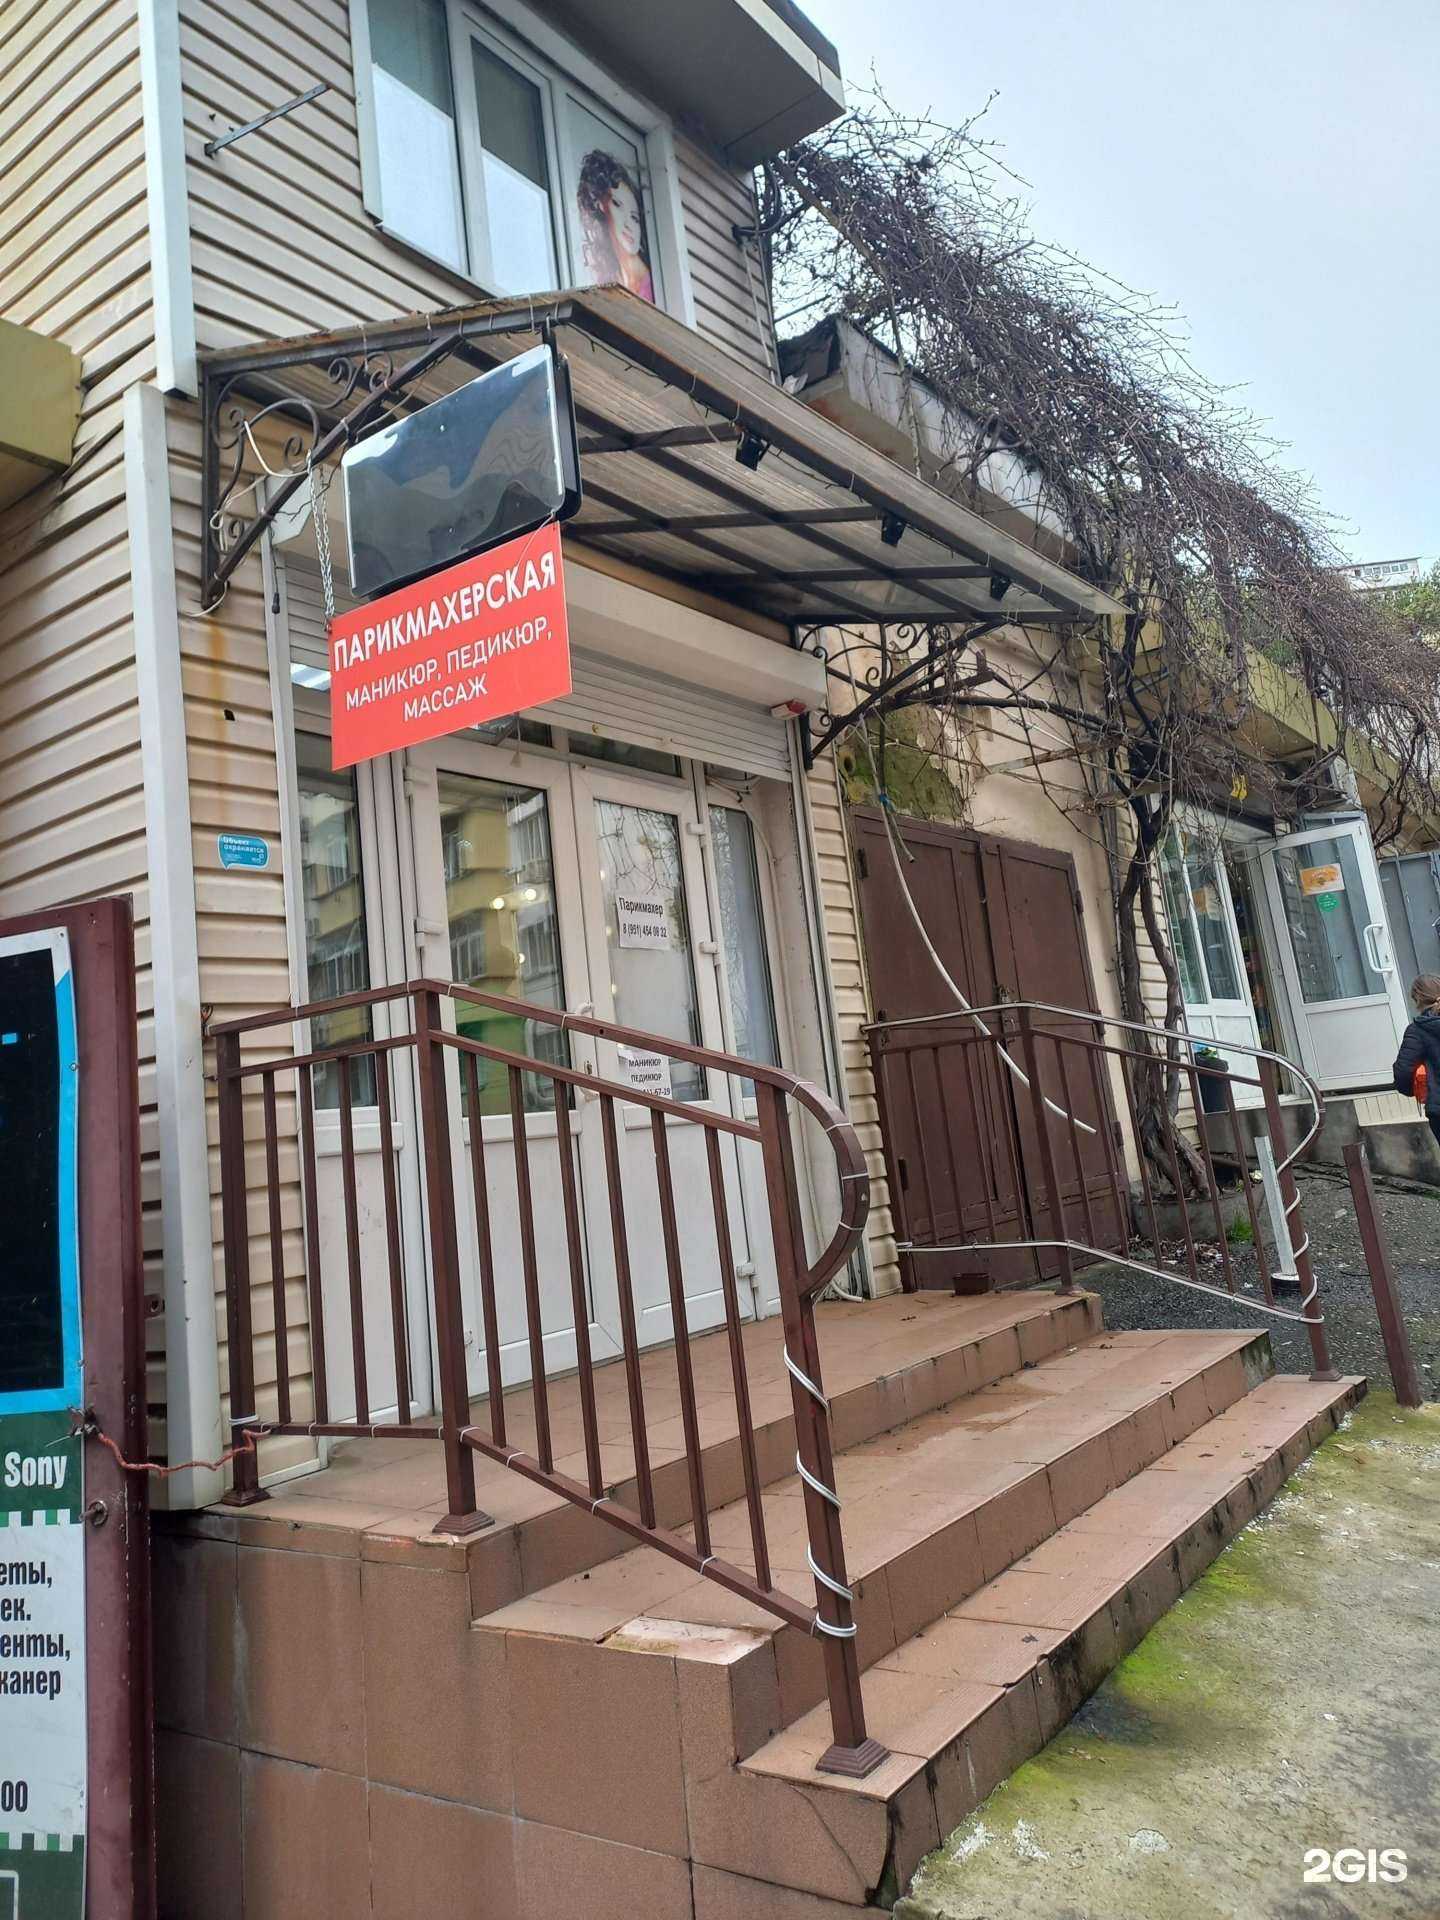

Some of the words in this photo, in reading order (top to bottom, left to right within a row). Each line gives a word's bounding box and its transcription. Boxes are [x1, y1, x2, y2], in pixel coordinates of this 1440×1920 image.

[333, 551, 556, 672] ПАРИКМАХЕРСКАЯ
[345, 658, 442, 711] МАНИКЮР,
[446, 616, 552, 673] ПЕДИКЮР,
[403, 673, 488, 722] МАССАЖ
[619, 897, 664, 918] Парикмахер
[623, 923, 628, 935] 8
[628, 924, 642, 939] (951)
[628, 1058, 662, 1067] МАНИКЮР
[630, 1073, 662, 1084] ПЕДИКЮР
[4, 1451, 68, 1490] Sony
[1, 1780, 28, 1812] 00
